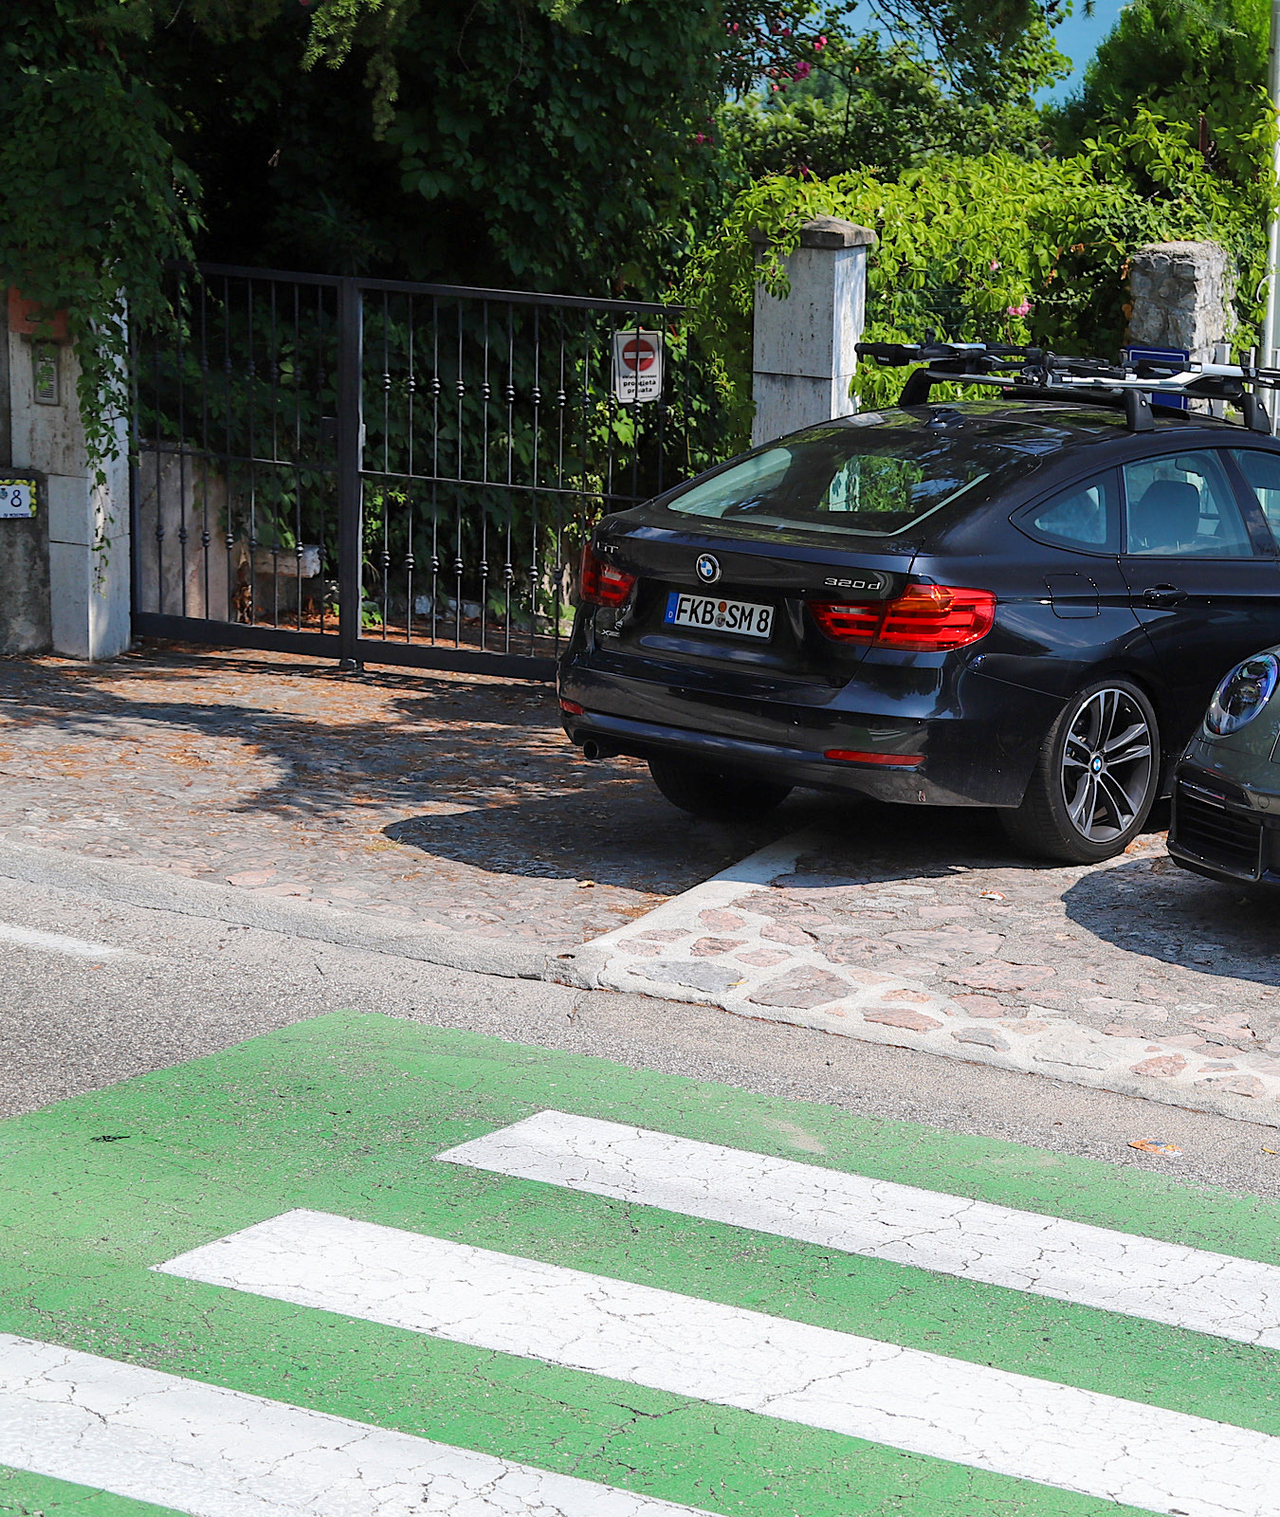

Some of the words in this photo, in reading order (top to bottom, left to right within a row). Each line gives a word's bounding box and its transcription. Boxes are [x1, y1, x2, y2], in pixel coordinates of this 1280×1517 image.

[10, 489, 22, 507] 8
[676, 597, 716, 625] FKB
[725, 604, 755, 632] SM
[756, 608, 770, 633] 8
